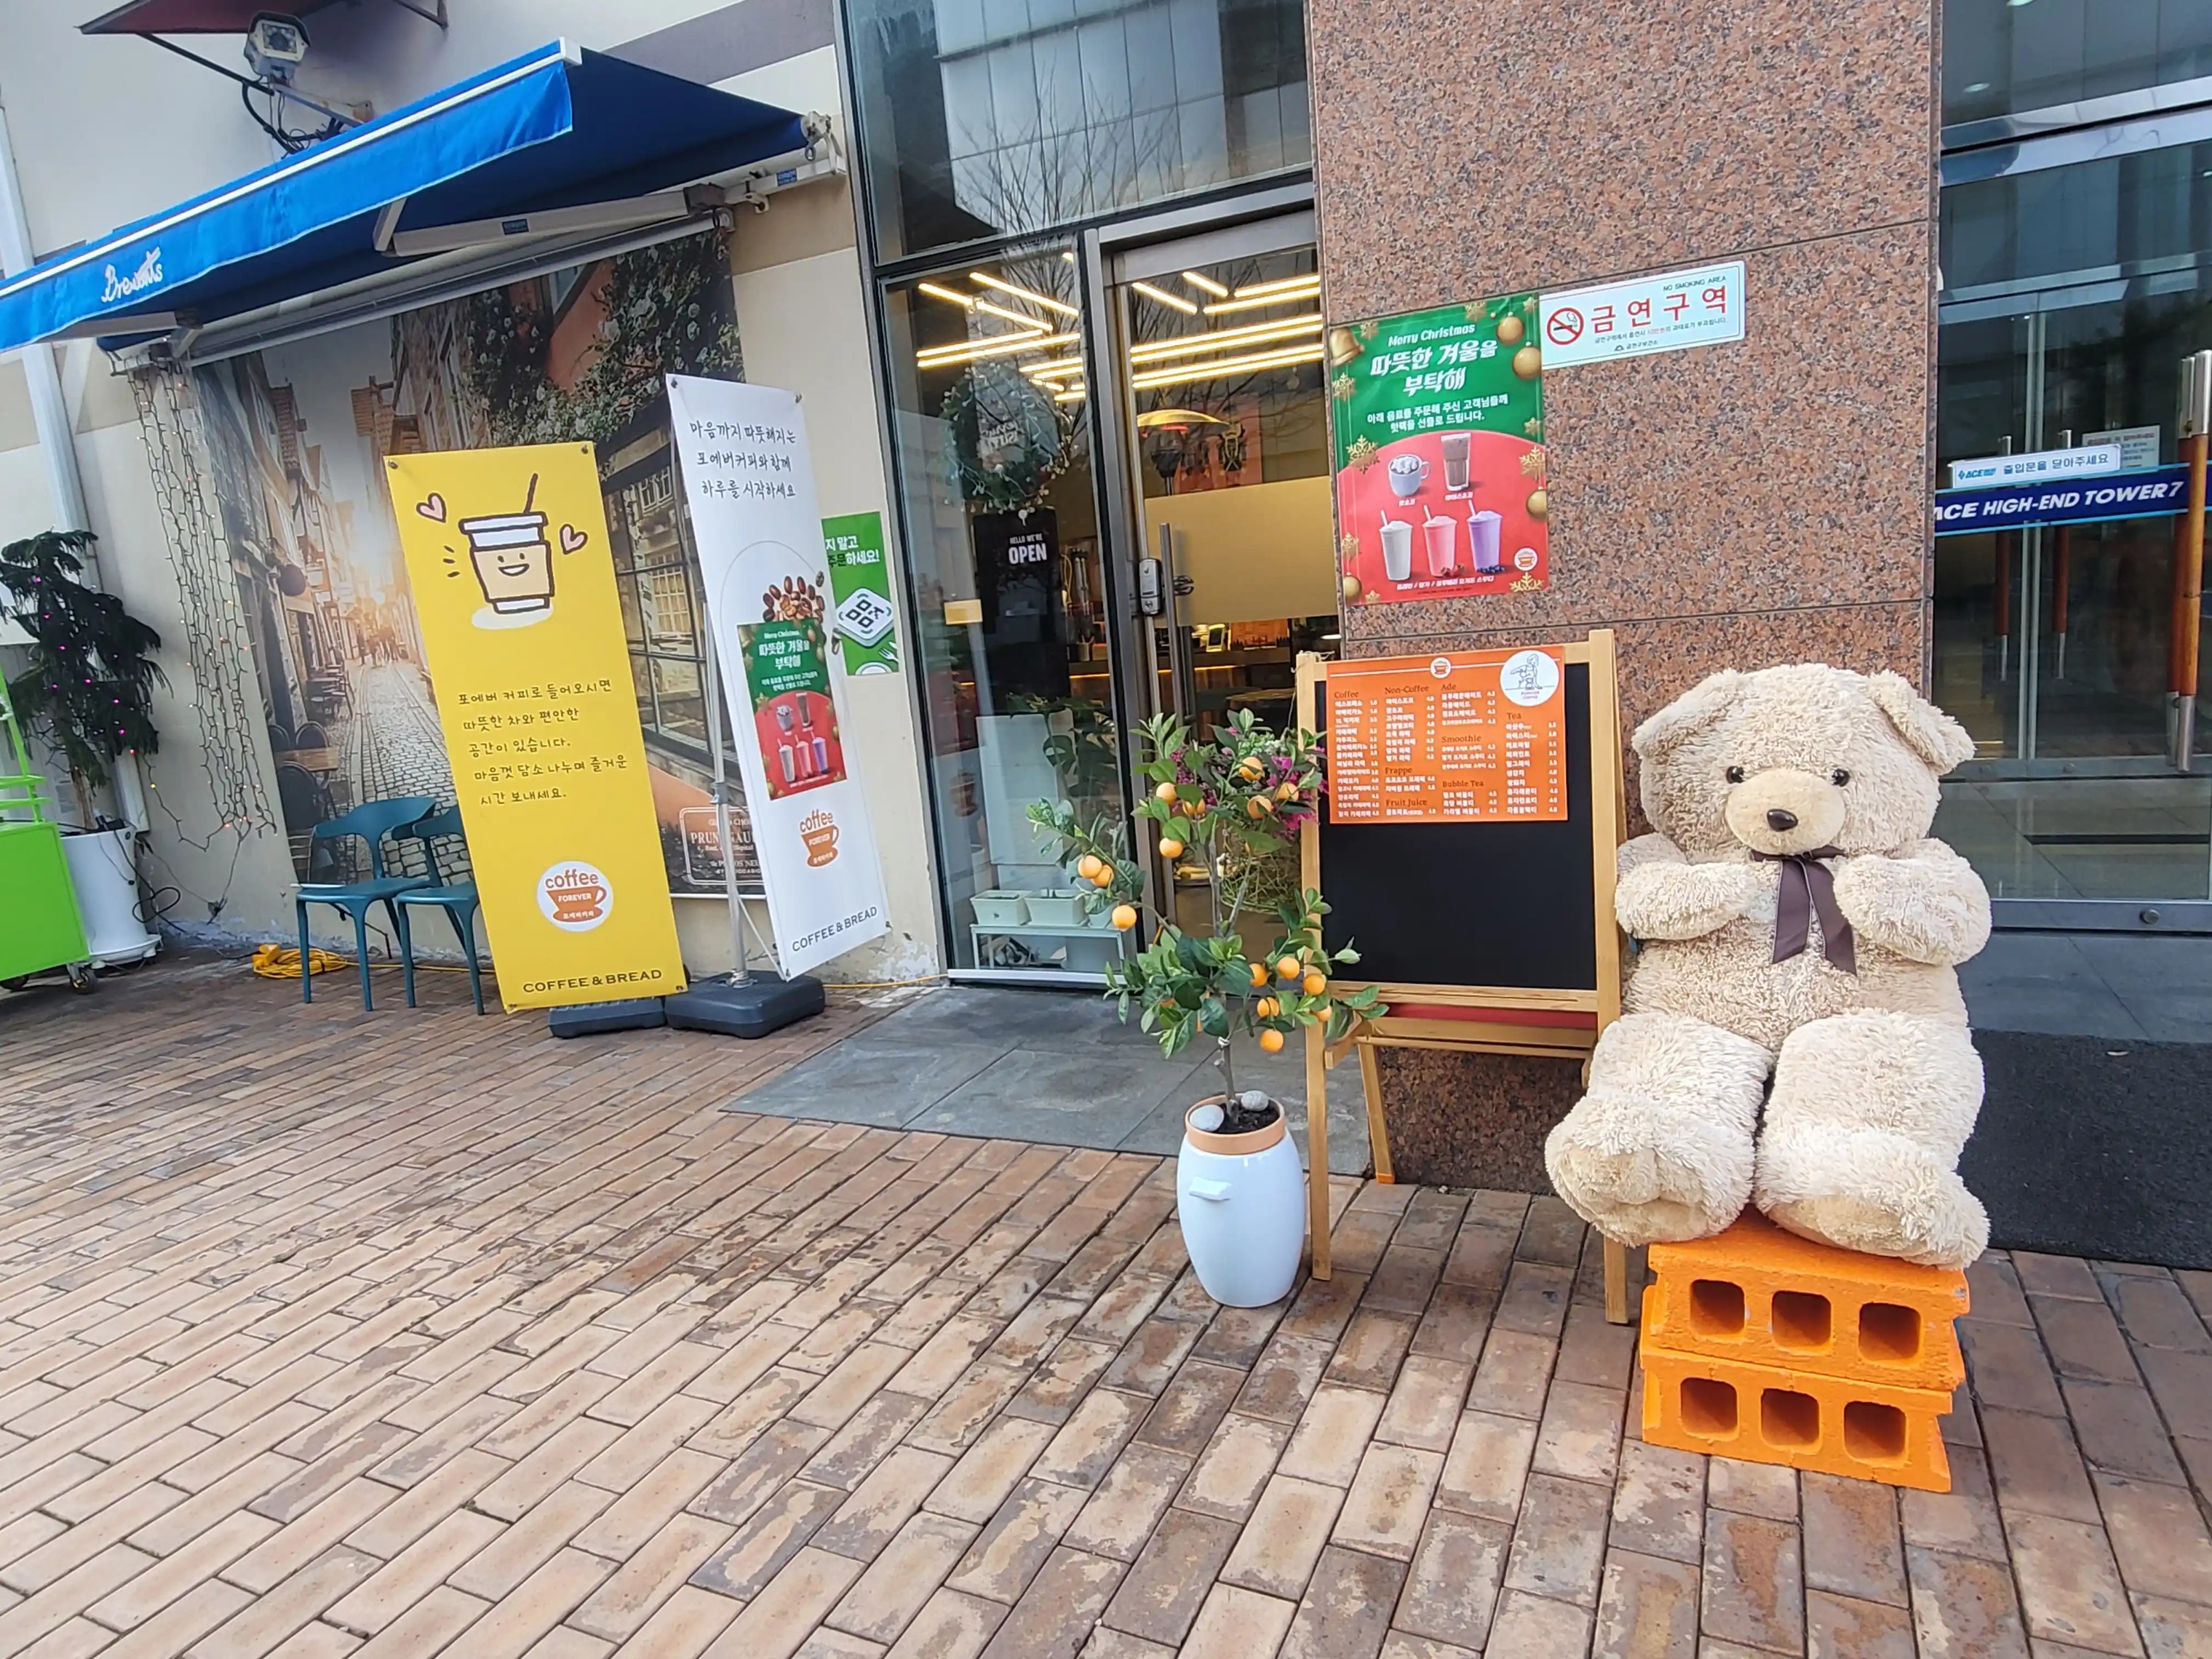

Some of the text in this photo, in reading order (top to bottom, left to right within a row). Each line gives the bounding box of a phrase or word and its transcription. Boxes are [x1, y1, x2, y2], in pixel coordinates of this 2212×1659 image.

[1675, 279, 1705, 290] SMOKING
[1708, 276, 1726, 284] AREA
[1388, 325, 1476, 347] Merry Christmas
[1370, 339, 1498, 377] 따뜻한 겨울을
[1403, 367, 1466, 397] 부탁해
[1367, 394, 1508, 425] 아래 음료를 주문해 주신 고객님들께
[690, 420, 796, 445] 마음까지 따뜻해지는
[1417, 415, 1444, 429] 선물로
[697, 450, 792, 472] 포에버커피와 함께
[2004, 461, 2047, 474] 출입문을
[1965, 469, 1983, 479] ACE
[702, 480, 796, 501] 하루를 시작하세요
[1982, 492, 2080, 516] HIGH-END
[2085, 483, 2167, 505] TOWER
[2168, 481, 2184, 498] 7
[837, 536, 859, 551] 말고
[1008, 544, 1047, 565] OPEN
[458, 679, 611, 705] 포에버 커피로 들어오시면
[1334, 691, 1359, 699] Coffee
[1385, 685, 1429, 694] Non-Coffee
[464, 707, 579, 732] 따뜻한 차와 편안한
[469, 736, 570, 758] 공간이 있습니다.
[1441, 735, 1481, 743] Smoothie
[474, 755, 627, 782] 마음껏 담소 나누며 즐거운
[1385, 767, 1413, 776] Frappe
[1442, 780, 1469, 788] Bubble
[481, 788, 567, 805] 시간 보내세요.
[1386, 798, 1428, 807] Fruit Juice
[800, 808, 834, 832] coffee
[545, 869, 599, 888] coffee
[558, 893, 592, 903] FOREVER
[792, 925, 835, 952] COFFEE
[844, 907, 878, 929] BREAD
[523, 969, 662, 993] COFFEE & BREAD
